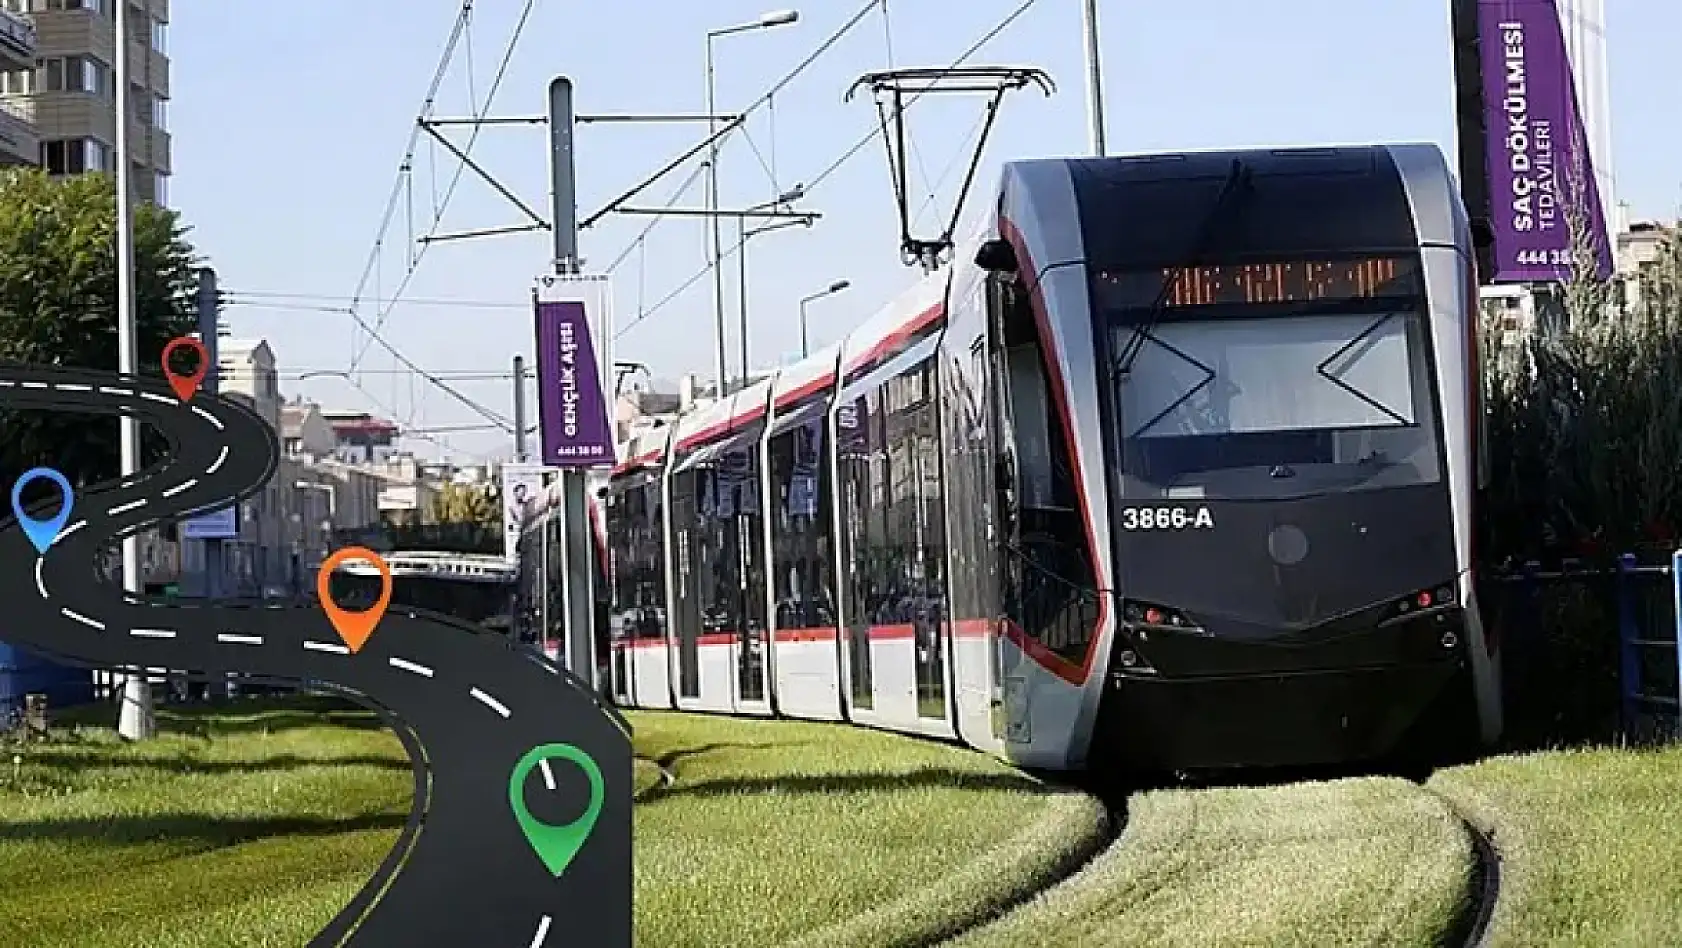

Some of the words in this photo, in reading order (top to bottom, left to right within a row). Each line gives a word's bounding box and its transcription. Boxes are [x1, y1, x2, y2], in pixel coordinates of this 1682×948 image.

[1498, 22, 1530, 172] DÖKÜLMESİ
[1532, 120, 1555, 230] TEDAVİLERİ
[1512, 177, 1537, 232] SAÇ
[1517, 249, 1547, 265] 444
[1122, 508, 1214, 529] 3866-A
